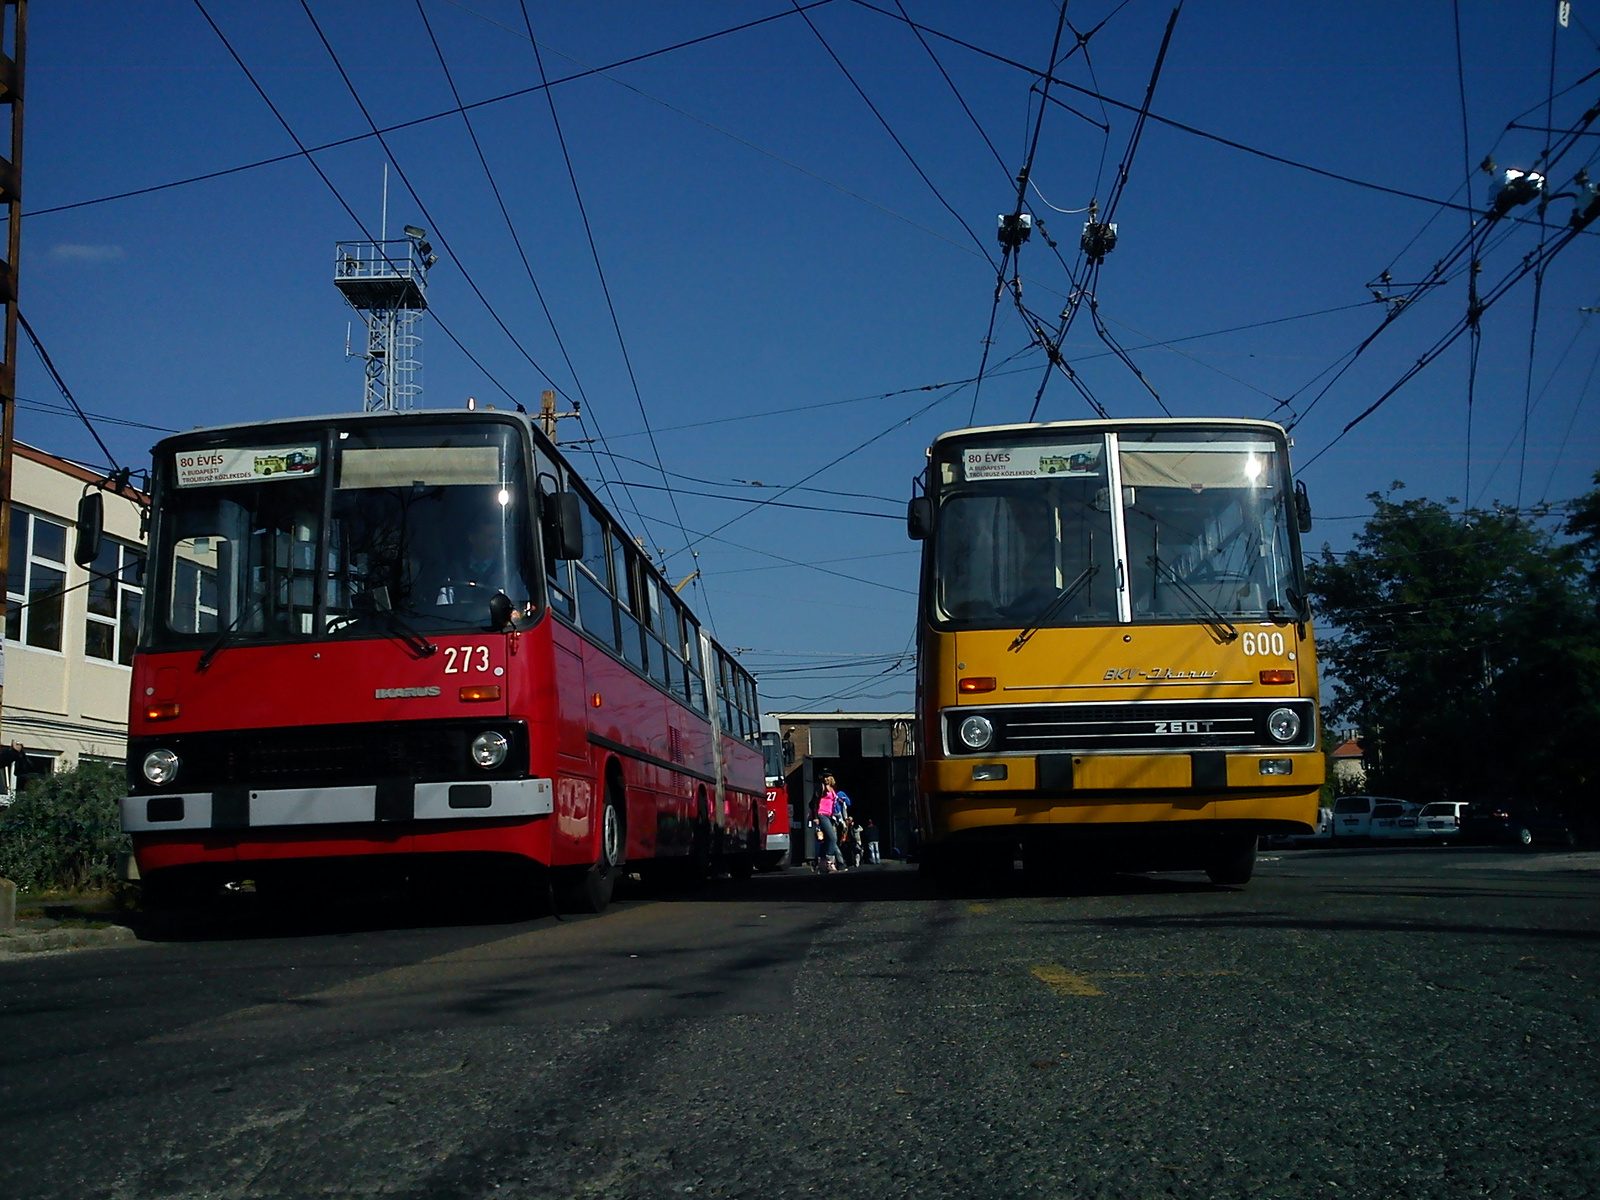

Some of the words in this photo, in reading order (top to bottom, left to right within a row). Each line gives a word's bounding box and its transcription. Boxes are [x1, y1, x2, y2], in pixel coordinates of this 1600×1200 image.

[180, 457, 194, 467] 80
[197, 455, 224, 466] ÉVES
[968, 455, 981, 463] 80
[985, 453, 1010, 462] ÉVES
[187, 468, 219, 476] BUDAPESTI
[1242, 631, 1285, 656] 600
[444, 646, 489, 674] 273
[375, 686, 441, 699] IKARUS
